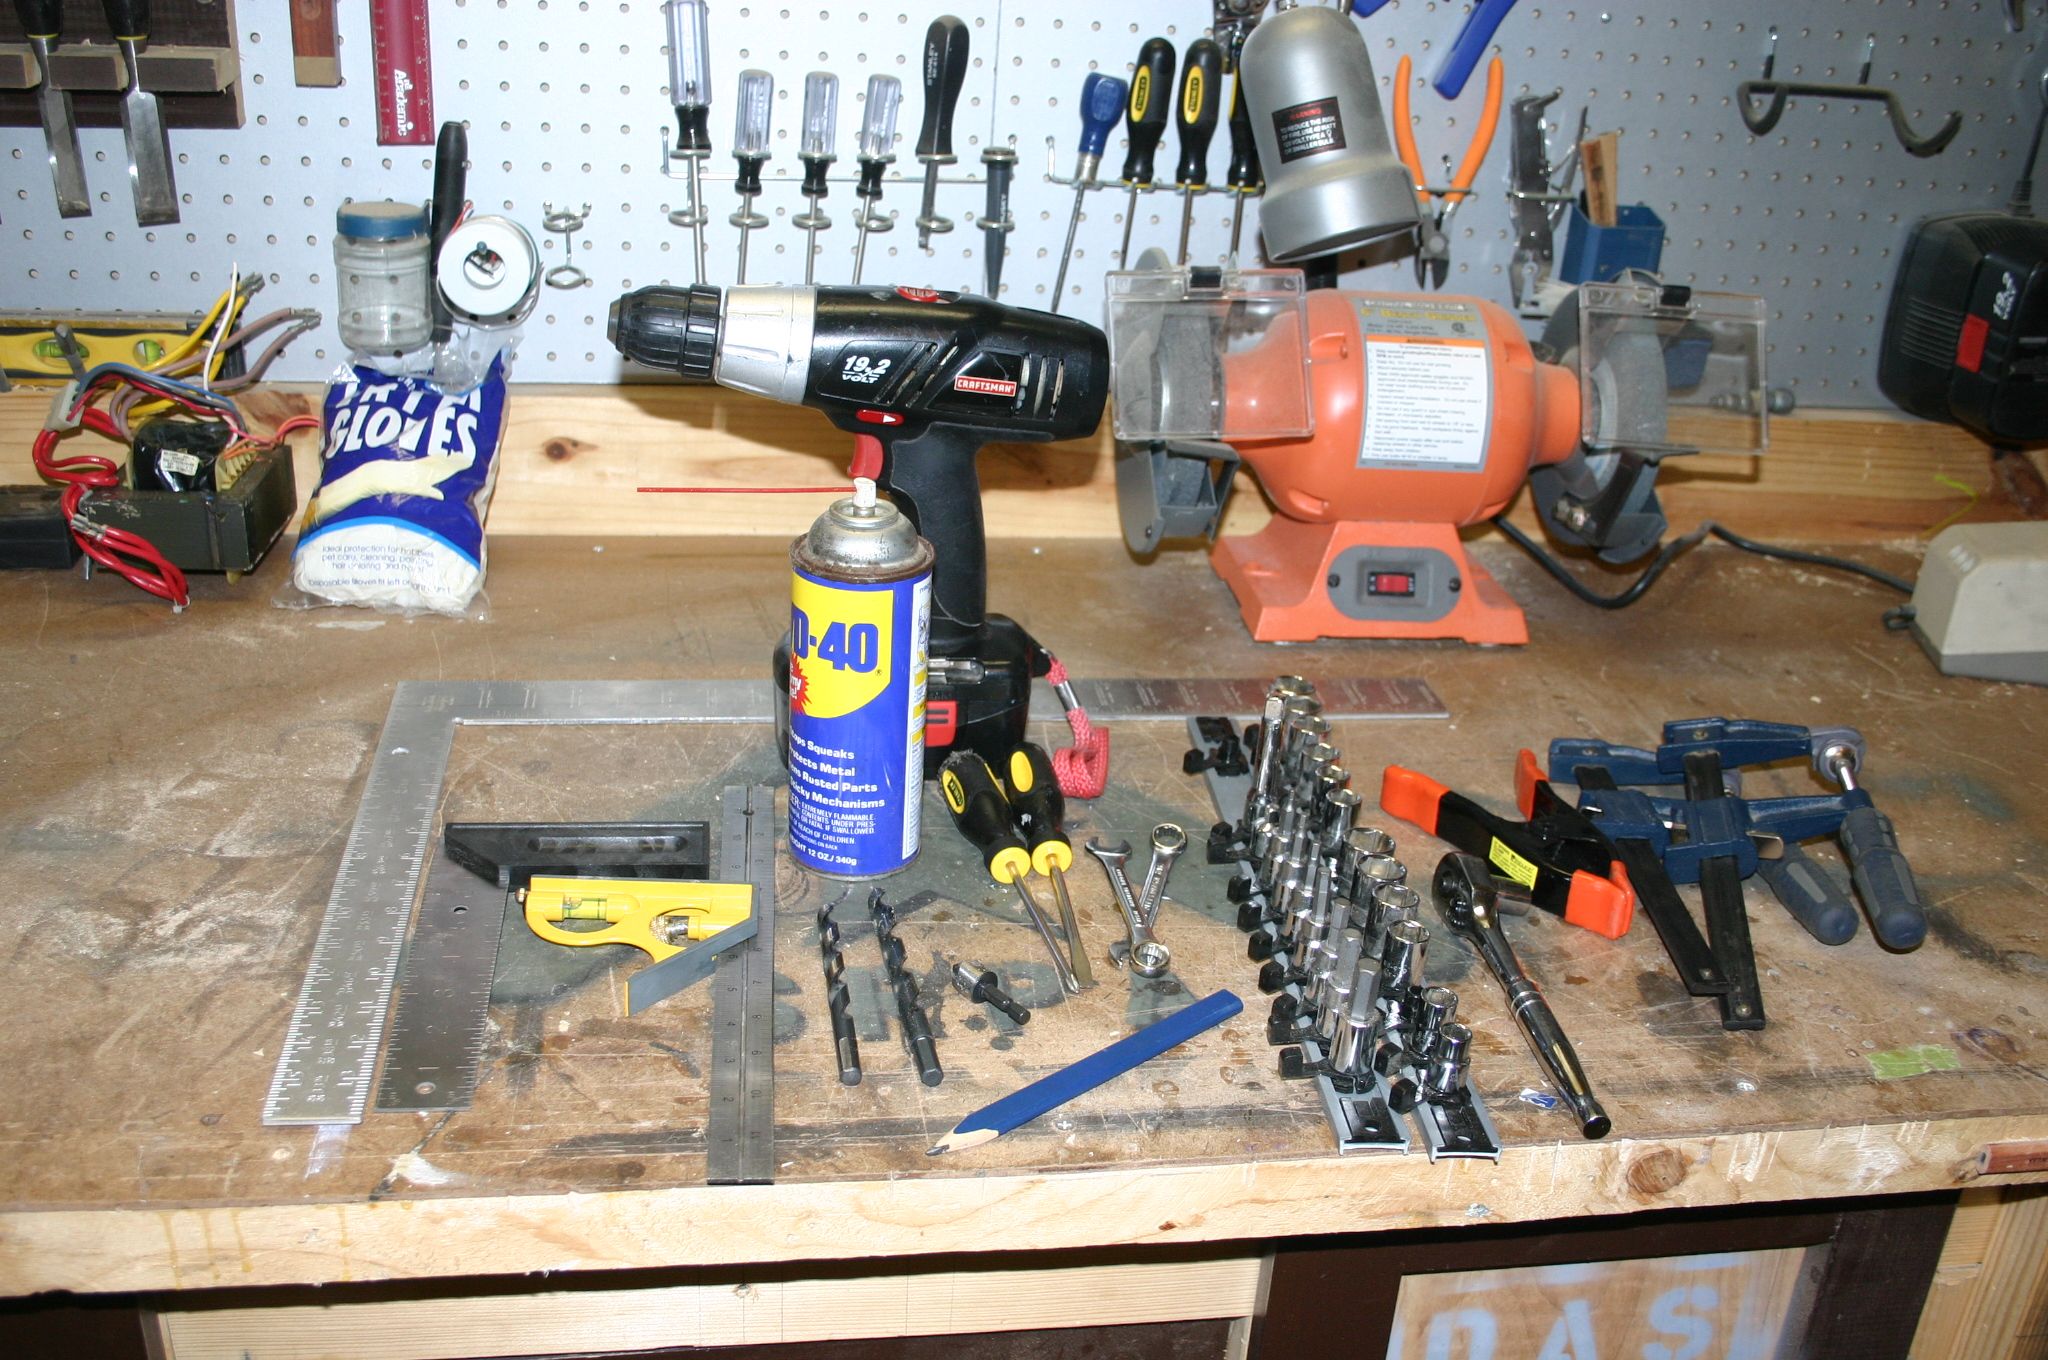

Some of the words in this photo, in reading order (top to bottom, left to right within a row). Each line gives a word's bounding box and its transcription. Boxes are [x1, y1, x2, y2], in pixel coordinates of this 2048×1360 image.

[394, 68, 413, 136] Academic
[843, 355, 891, 374] 19.2
[842, 374, 879, 384] VOLT
[957, 380, 1015, 393] CRAFTSMAN
[325, 403, 478, 468] GLOVES
[788, 602, 879, 674] D-40
[807, 740, 855, 760] Squeaks
[820, 762, 856, 777] Metal
[802, 771, 839, 791] Rusted
[841, 782, 878, 793] Parts
[790, 776, 811, 800] ticky
[811, 791, 885, 809] Mechanisms
[801, 801, 833, 818] EXTREMELY
[831, 819, 854, 828] UNDER
[808, 848, 816, 857] 12
[835, 855, 858, 866] 340g
